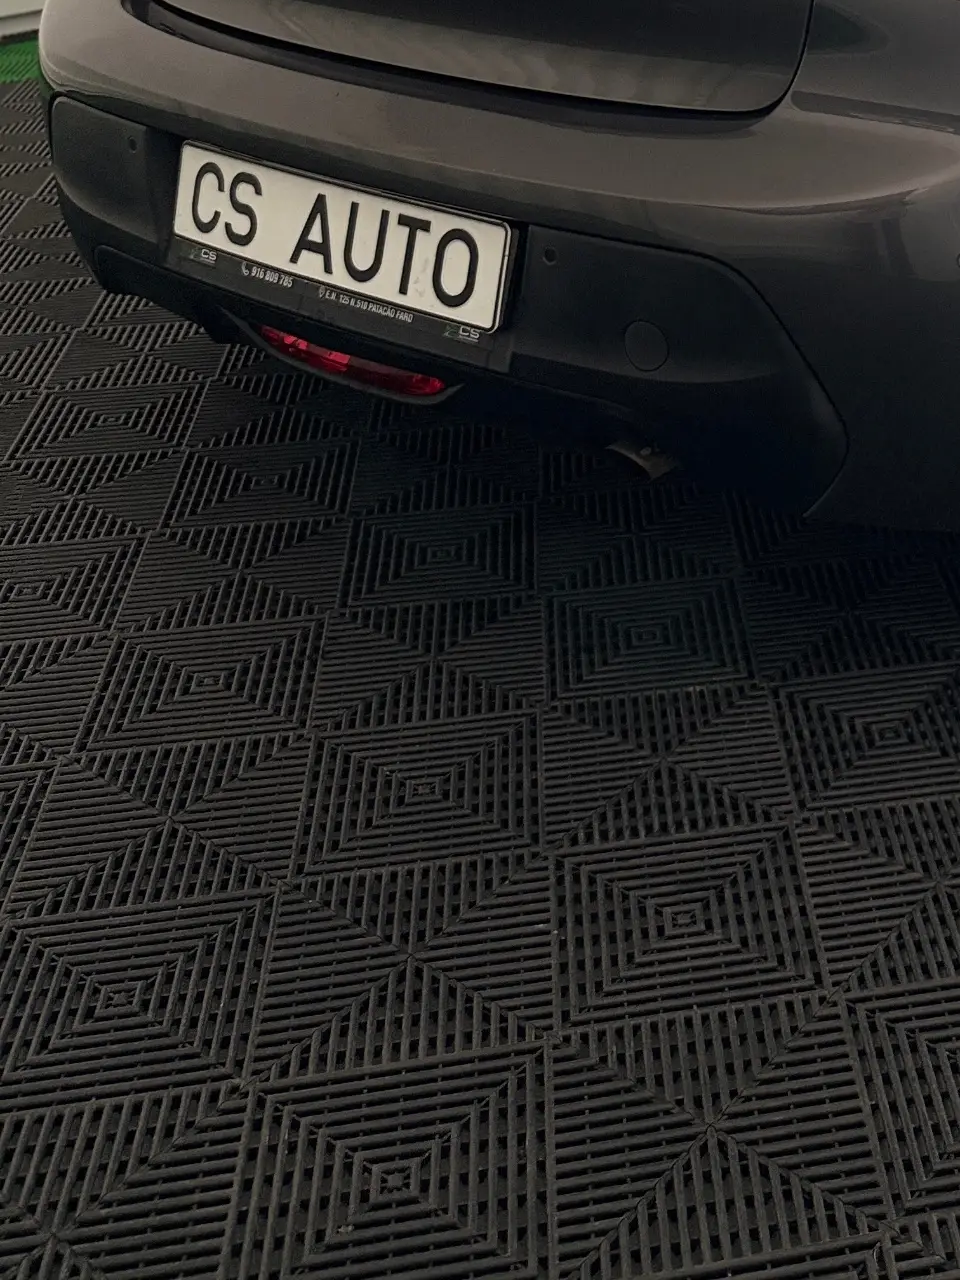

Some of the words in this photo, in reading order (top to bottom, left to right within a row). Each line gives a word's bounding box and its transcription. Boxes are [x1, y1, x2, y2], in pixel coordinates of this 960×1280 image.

[191, 161, 263, 247] CS
[289, 192, 479, 308] AUTO
[201, 248, 217, 260] CS
[251, 266, 264, 279] 916
[265, 270, 279, 283] 809
[280, 274, 293, 288] 785
[339, 294, 350, 305] 125
[395, 310, 414, 323] FARO
[458, 326, 480, 339] CS
